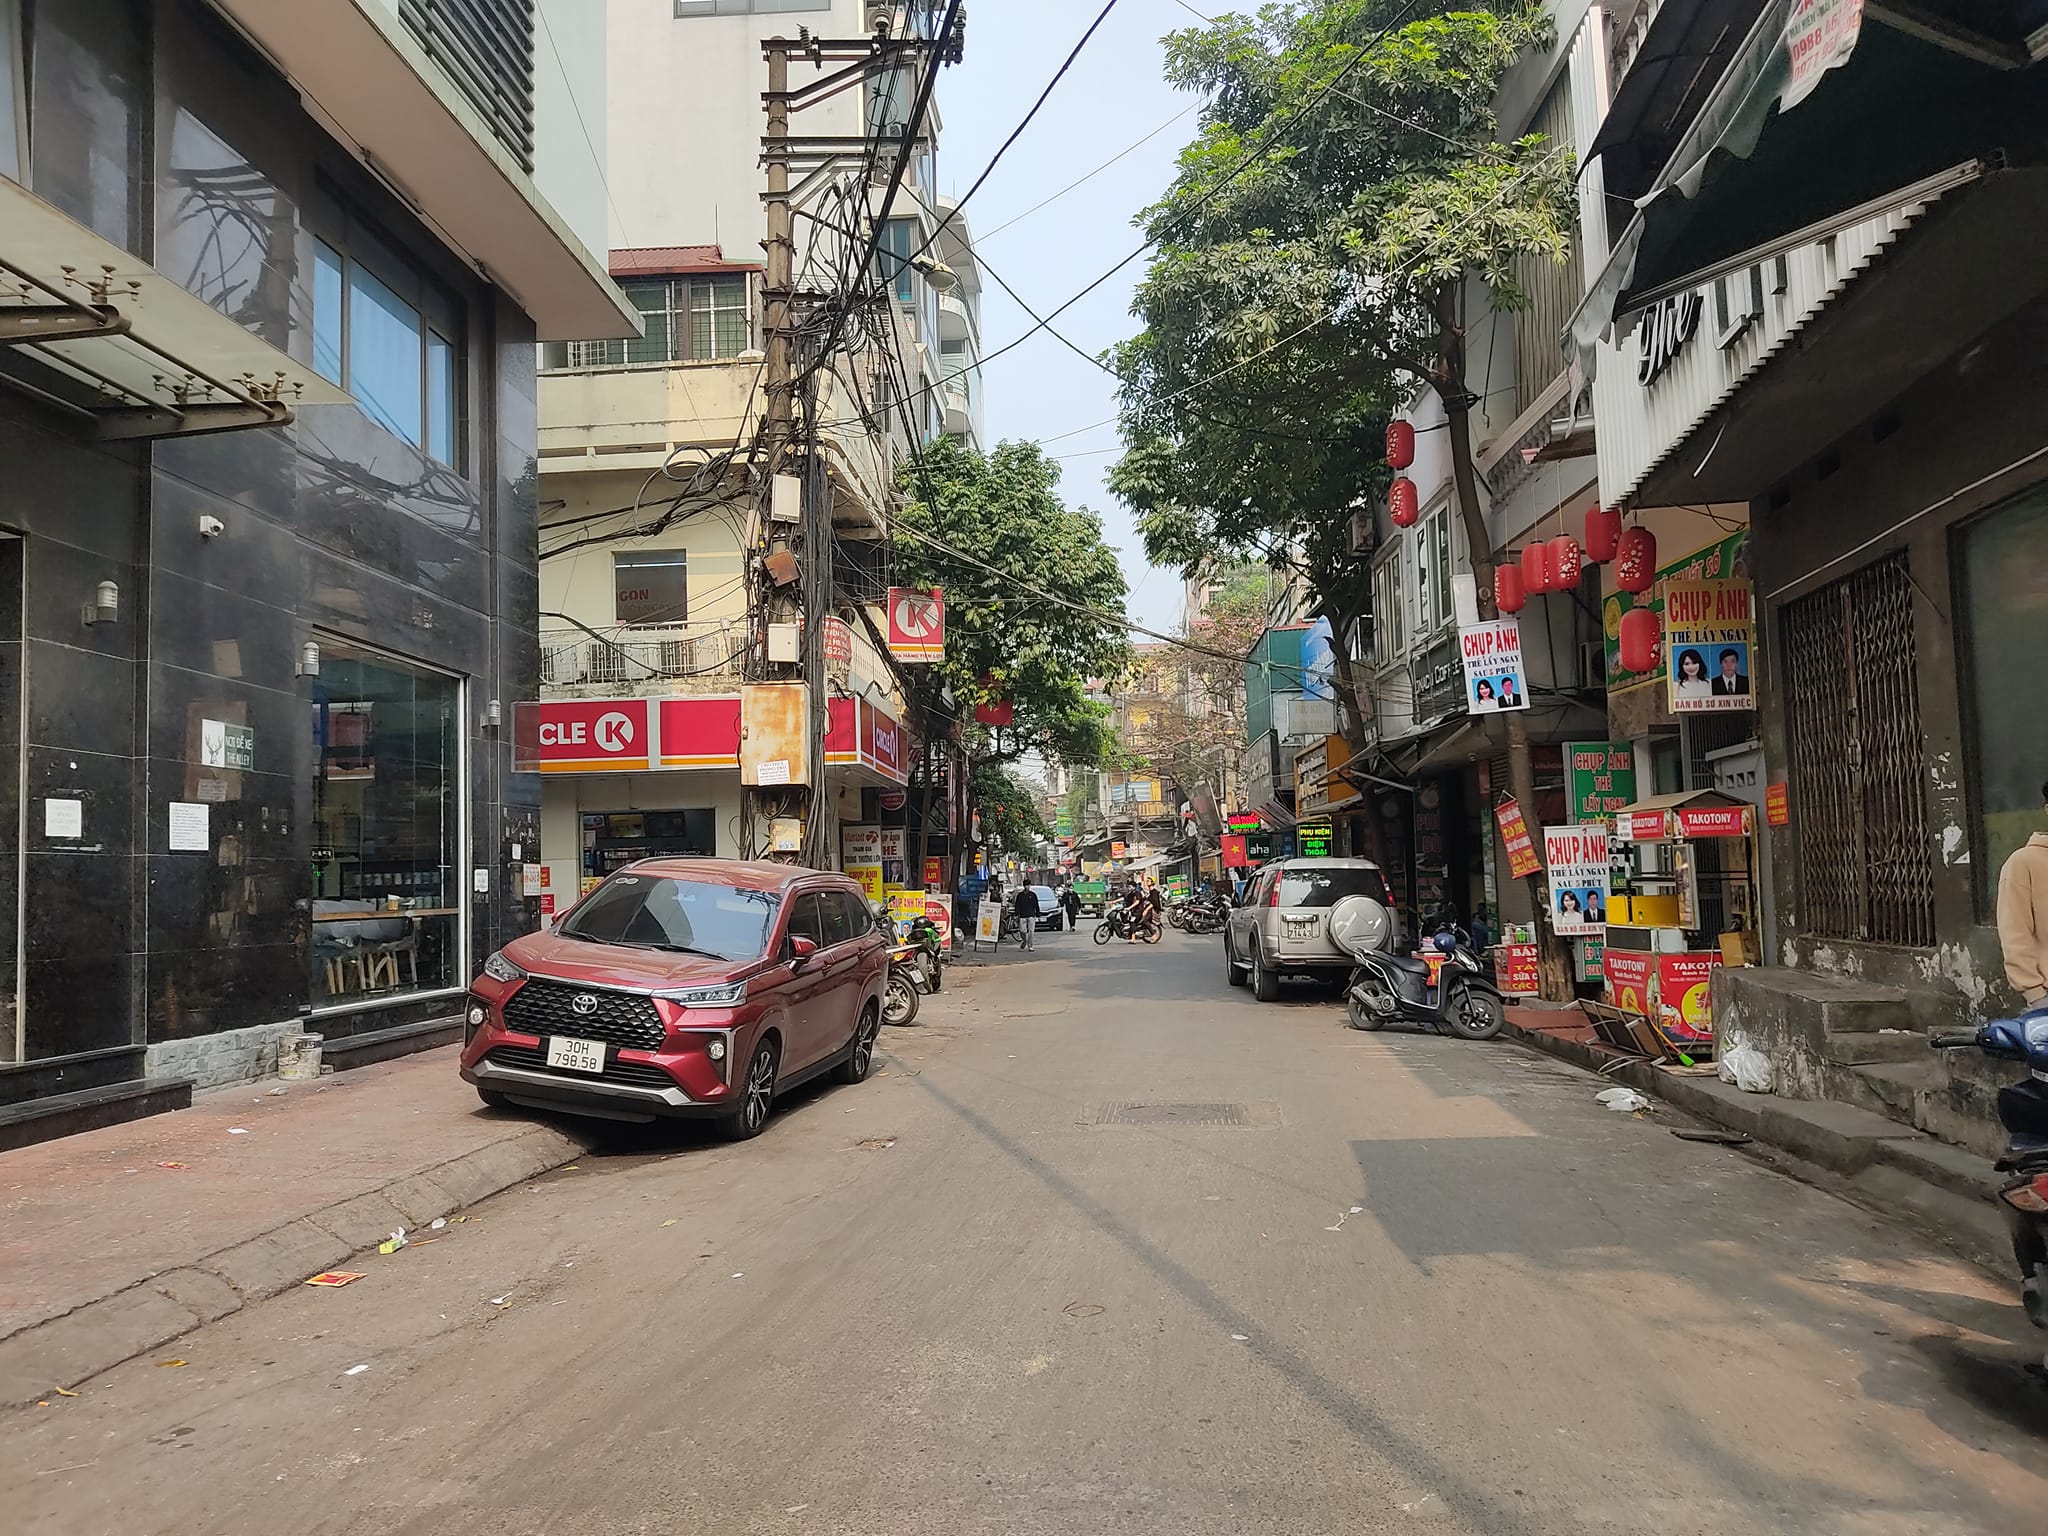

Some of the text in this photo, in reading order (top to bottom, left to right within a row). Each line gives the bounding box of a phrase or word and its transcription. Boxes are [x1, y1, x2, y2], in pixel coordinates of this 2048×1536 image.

[1792, 27, 1822, 61] 0988
[1669, 580, 1749, 627] CHỤP ẢNH
[1463, 623, 1519, 660] CHỤP ẢNH
[1695, 625, 1717, 643] LẤY
[1720, 628, 1749, 642] NGAY
[1500, 654, 1520, 664] NGAY
[1473, 669, 1488, 678] SAU
[1495, 664, 1516, 675] PHÚT
[1718, 699, 1731, 709] XIN
[1733, 698, 1751, 710] VIỆC
[1574, 745, 1631, 774] CHỤP ẢNH
[1594, 771, 1613, 791] THẺ
[1583, 792, 1601, 812] LẤY
[1688, 813, 1731, 825] TAKOTONY
[1250, 843, 1270, 854] aha
[1546, 836, 1580, 869] CHỤP
[1582, 827, 1608, 865] ẢNH
[1586, 867, 1608, 876] NGAY
[1582, 877, 1602, 888] PHÚT
[1609, 957, 1646, 972] TAKOTONY
[565, 1040, 590, 1055] 30H
[554, 1052, 597, 1070] 798.58
